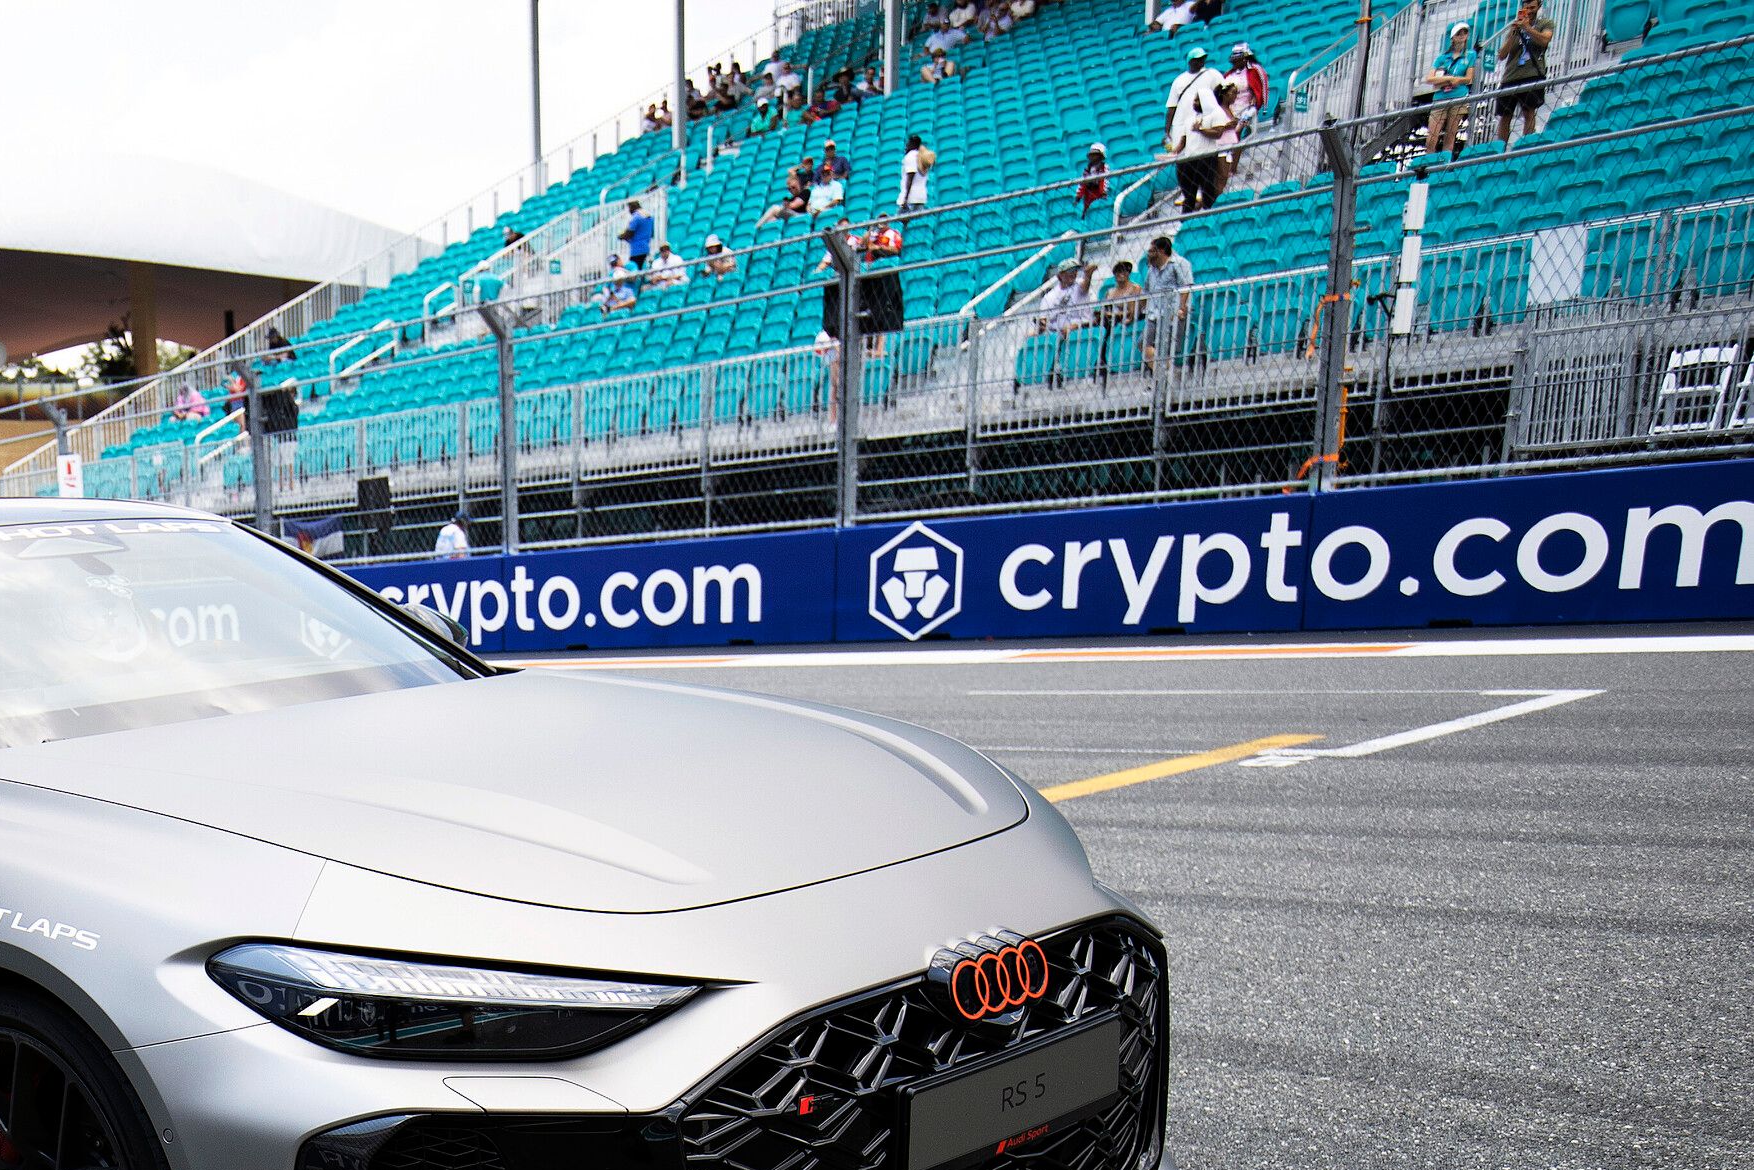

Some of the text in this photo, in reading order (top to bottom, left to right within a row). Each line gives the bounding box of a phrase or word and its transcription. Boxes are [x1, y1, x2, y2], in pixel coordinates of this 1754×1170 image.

[108, 520, 223, 535] LAPS
[998, 500, 1754, 625] crypto.com
[11, 912, 101, 951] LAPS
[1002, 1072, 1046, 1112] RS 5
[1006, 1123, 1051, 1148] Audi Sport
